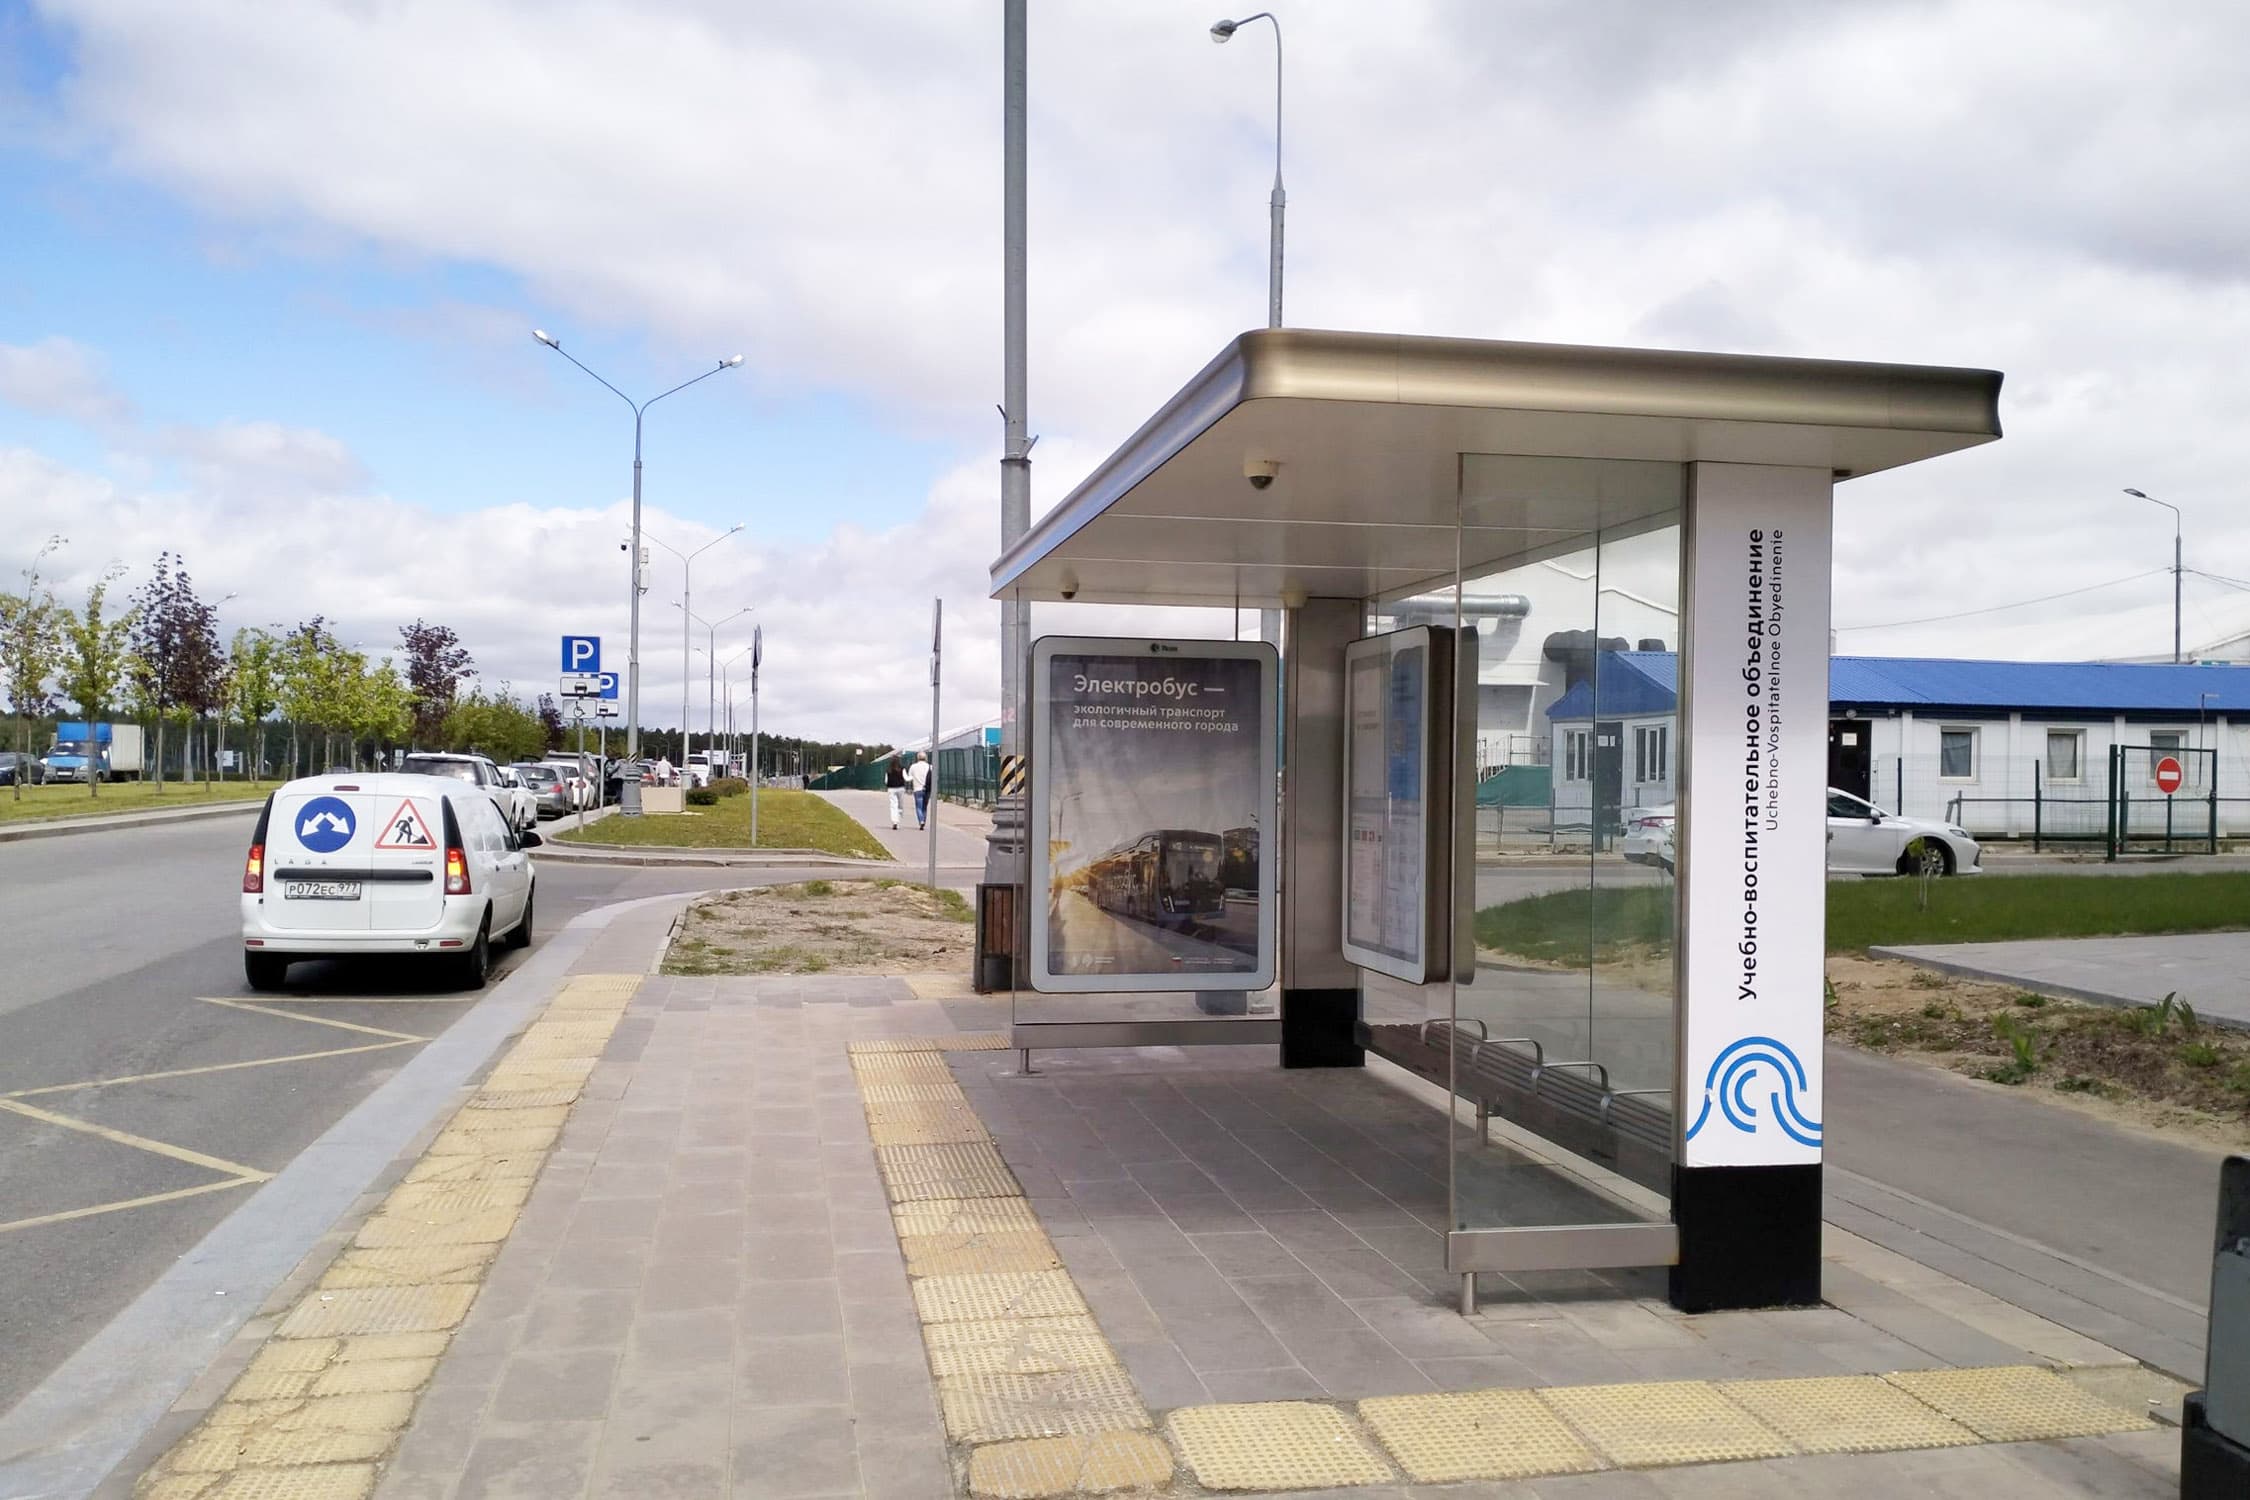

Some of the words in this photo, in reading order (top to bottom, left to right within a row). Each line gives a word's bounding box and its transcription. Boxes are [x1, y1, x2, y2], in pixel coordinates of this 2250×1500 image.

[1742, 528, 1765, 698] объединение
[1767, 529, 1785, 637] Obyedinenie
[572, 639, 594, 669] P
[1073, 674, 1198, 699] Электробус
[1072, 718, 1097, 729] для
[1100, 719, 1192, 731] современного
[1195, 721, 1239, 733] города
[1073, 704, 1158, 717] экологичный
[1160, 707, 1226, 720] транспорт
[1765, 640, 1781, 831] Uchebno-Vospitatelnoe
[1738, 703, 1760, 1001] Учебно-воспитательное
